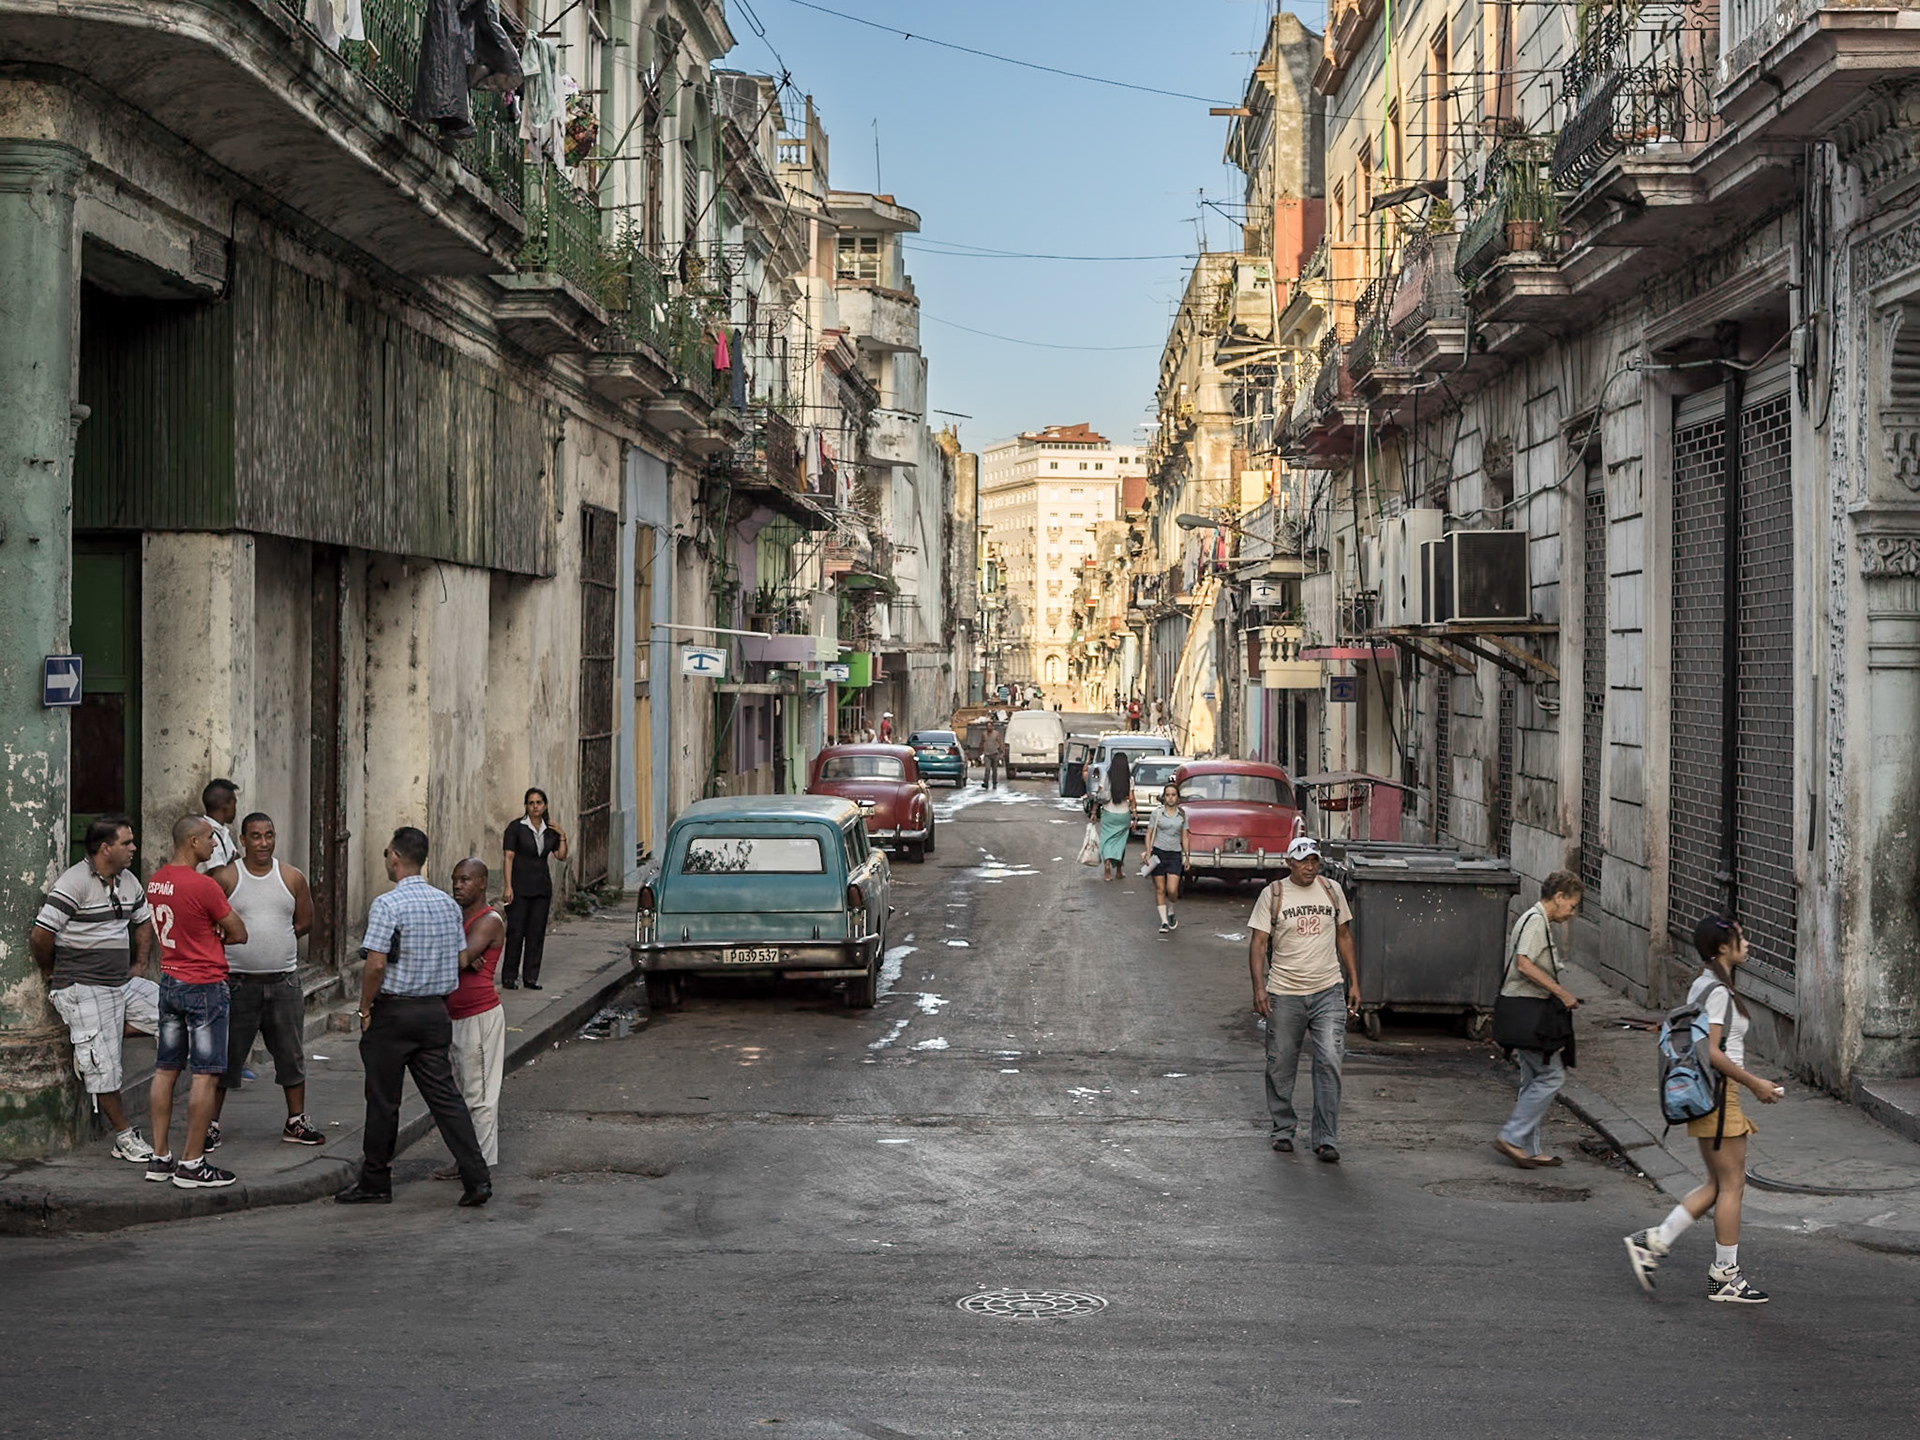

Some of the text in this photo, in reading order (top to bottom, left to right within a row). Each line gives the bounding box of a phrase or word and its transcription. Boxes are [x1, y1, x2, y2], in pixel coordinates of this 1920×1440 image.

[147, 881, 174, 896] ESPAÑA
[1282, 904, 1333, 920] PHATFARM
[148, 903, 176, 949] 12
[1297, 915, 1321, 936] 92
